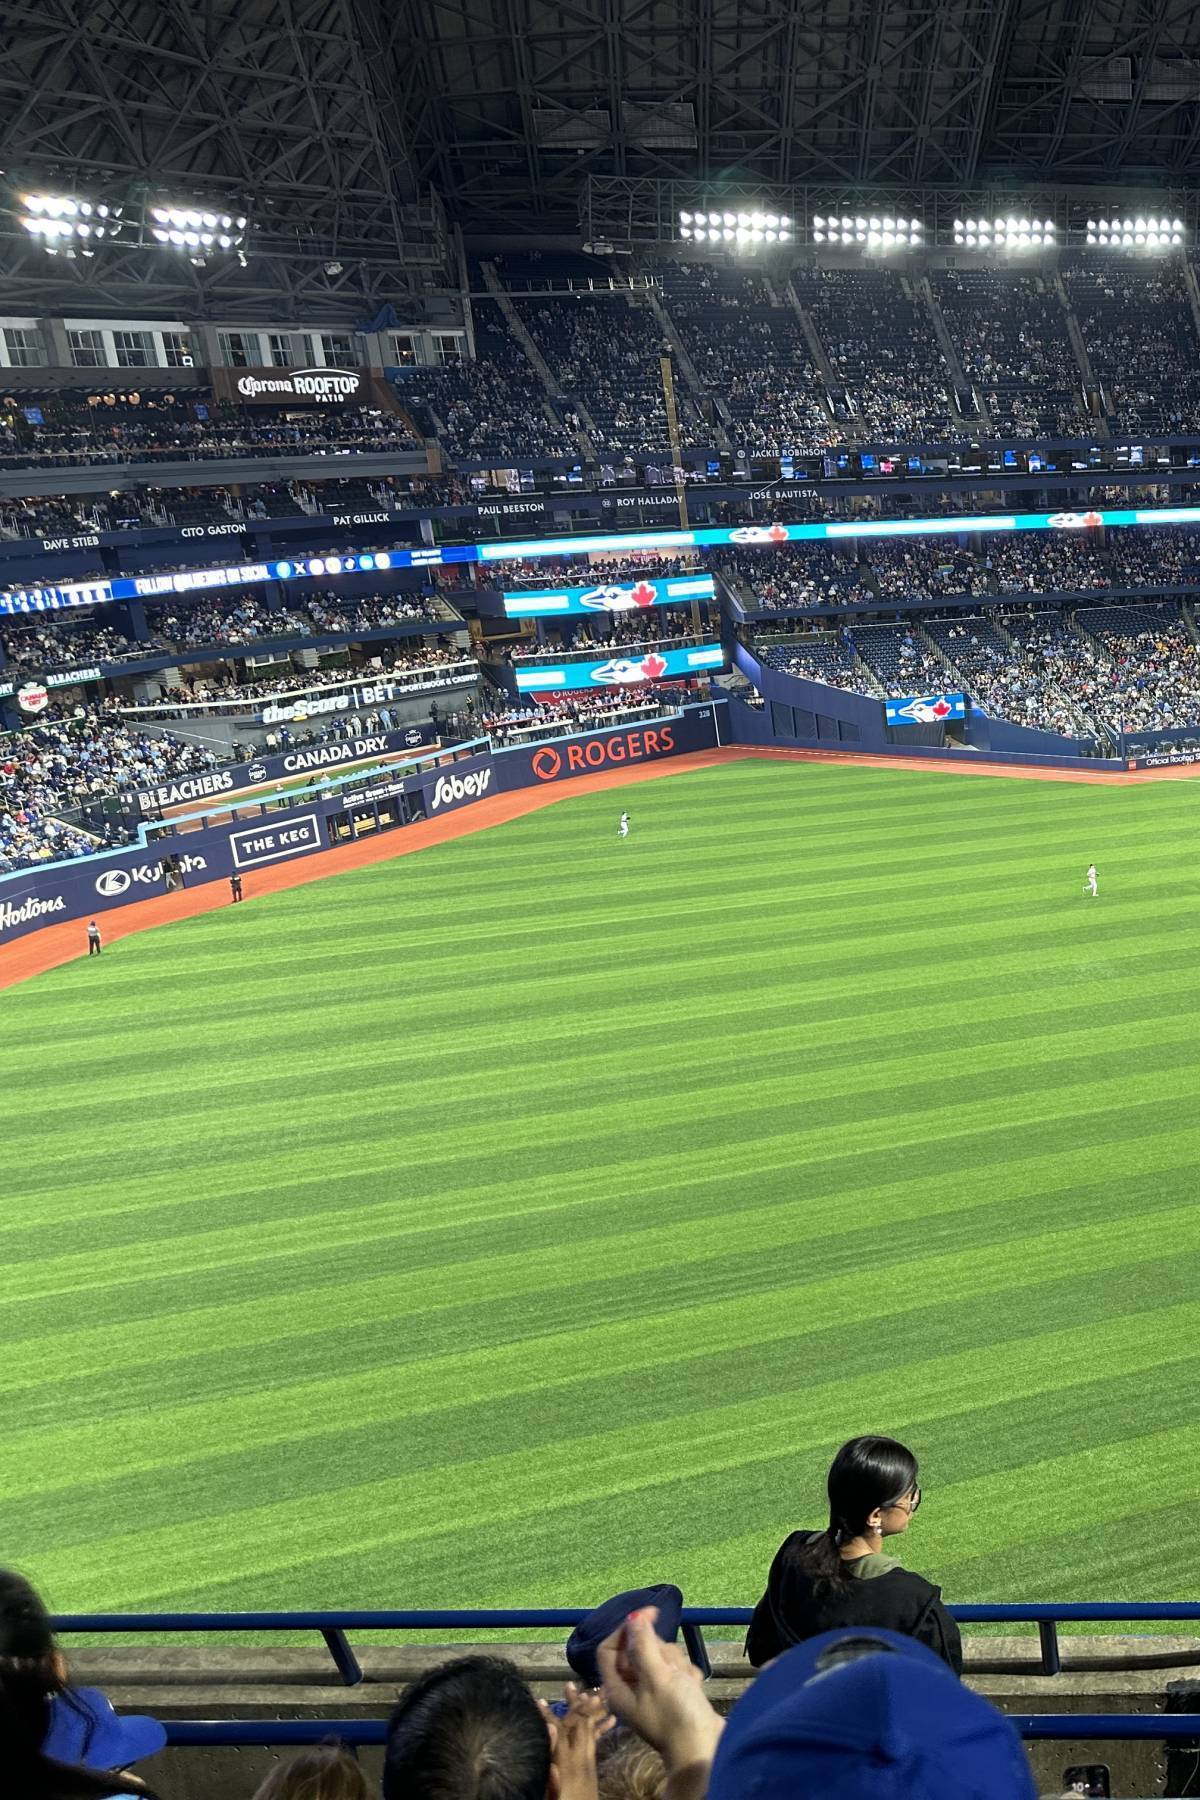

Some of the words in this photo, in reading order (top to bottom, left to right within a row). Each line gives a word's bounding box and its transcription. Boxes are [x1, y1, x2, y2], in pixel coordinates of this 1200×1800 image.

[238, 376, 293, 397] Corona
[294, 377, 359, 394] ROOFTOP
[316, 394, 344, 402] PATIO
[750, 449, 780, 458] JACKIE
[782, 448, 827, 457] ROBINSON
[617, 499, 636, 507] ROY
[638, 496, 682, 505] HALLADAY
[776, 490, 818, 498] BAUTISTA
[477, 506, 502, 515] PAUL
[503, 503, 545, 514] BEESTON
[333, 516, 352, 525] PAT
[353, 513, 390, 523] GILLICK
[181, 526, 204, 537] CITO
[207, 524, 246, 535] GASTON
[43, 539, 69, 550] DAVE
[72, 536, 99, 547] STIEB
[47, 668, 101, 685] BLEACHERS
[262, 694, 350, 724] theScore
[362, 684, 396, 704] BET
[283, 741, 353, 771] CANADA
[567, 727, 675, 770] ROGERS
[1146, 757, 1169, 766] Official
[139, 772, 233, 810] BLEACHERS
[432, 768, 491, 809] Sobeys
[343, 794, 364, 804] Active
[242, 835, 275, 854] THE
[281, 826, 310, 846] KEG
[132, 854, 208, 883] Kuota
[0, 895, 66, 931] Hortons
